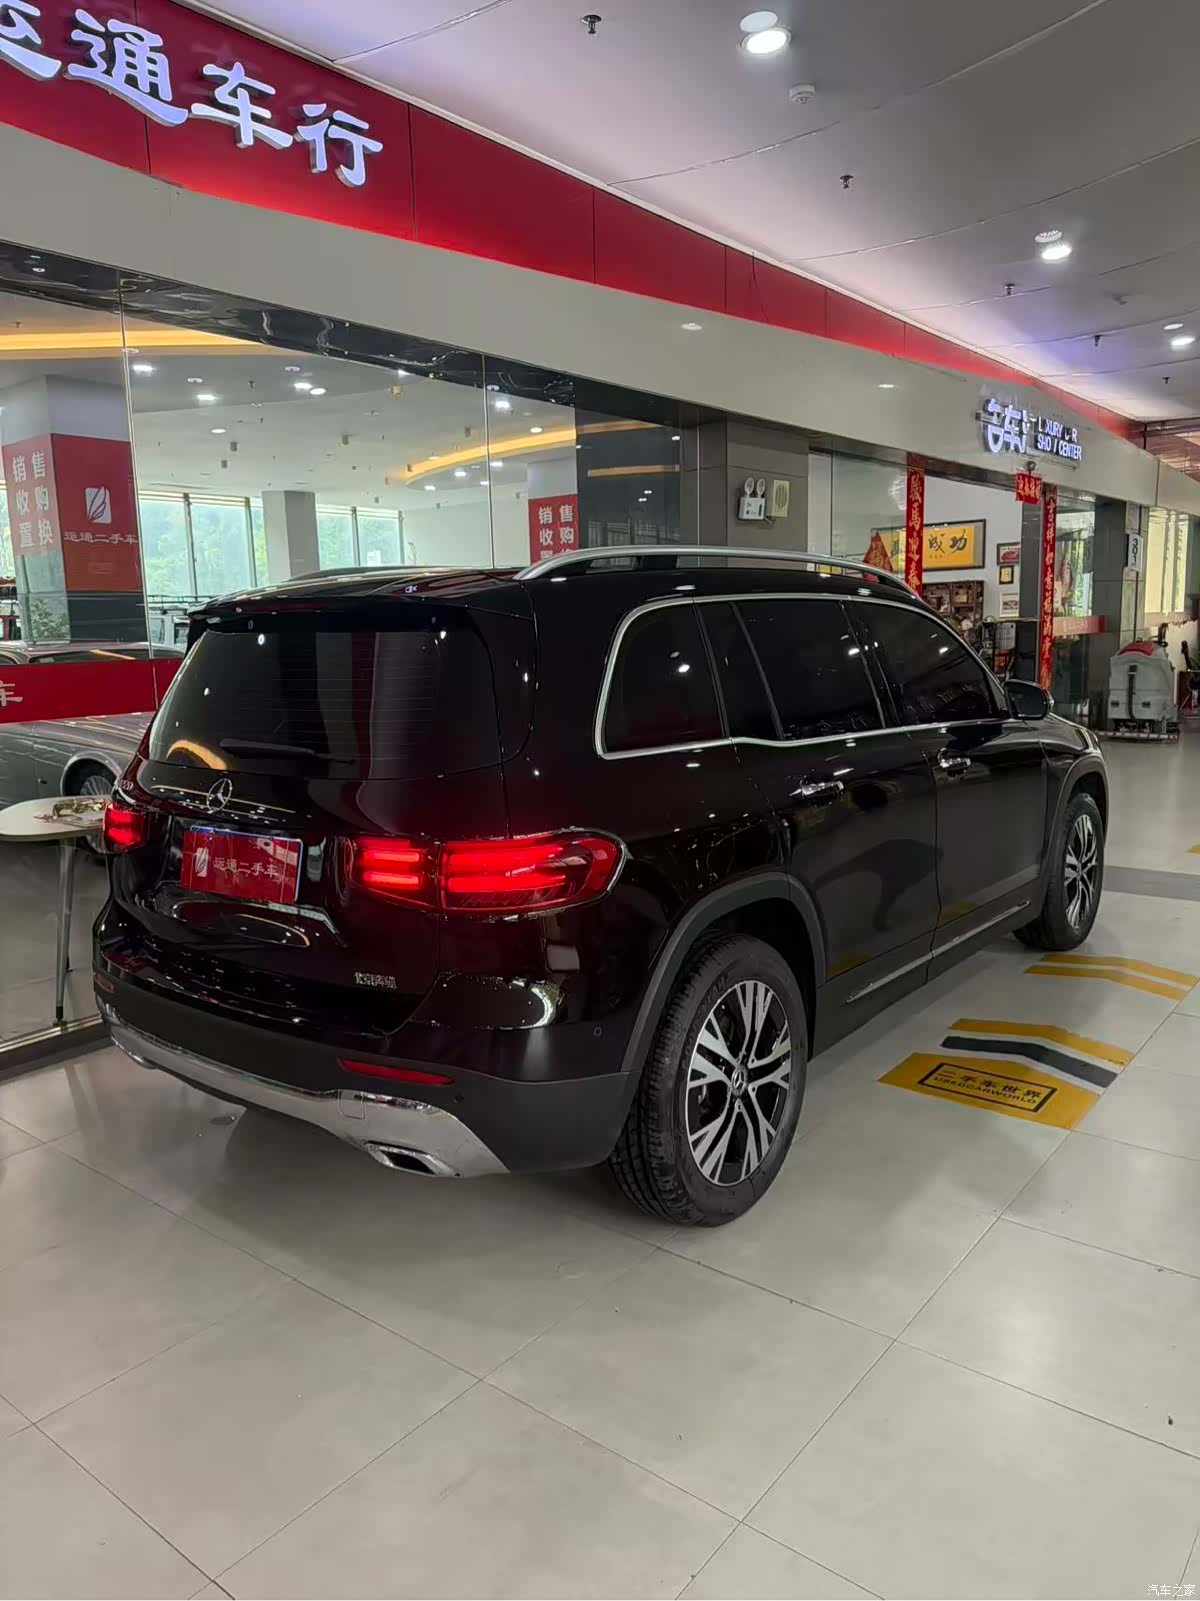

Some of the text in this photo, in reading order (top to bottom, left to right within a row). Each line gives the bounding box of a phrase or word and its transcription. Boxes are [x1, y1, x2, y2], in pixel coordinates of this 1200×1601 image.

[1037, 416, 1078, 443] LXURY CR
[1058, 440, 1082, 461] CENTER
[12, 450, 46, 483] 销售
[16, 486, 49, 515] 收购
[538, 503, 574, 525] 销售
[19, 519, 53, 549] 置换
[63, 530, 139, 545] 运通二手车
[539, 526, 575, 546] 收购
[1131, 537, 1139, 563] 301
[213, 856, 279, 878] 运通二手车
[937, 1070, 1041, 1098] 二手车世界
